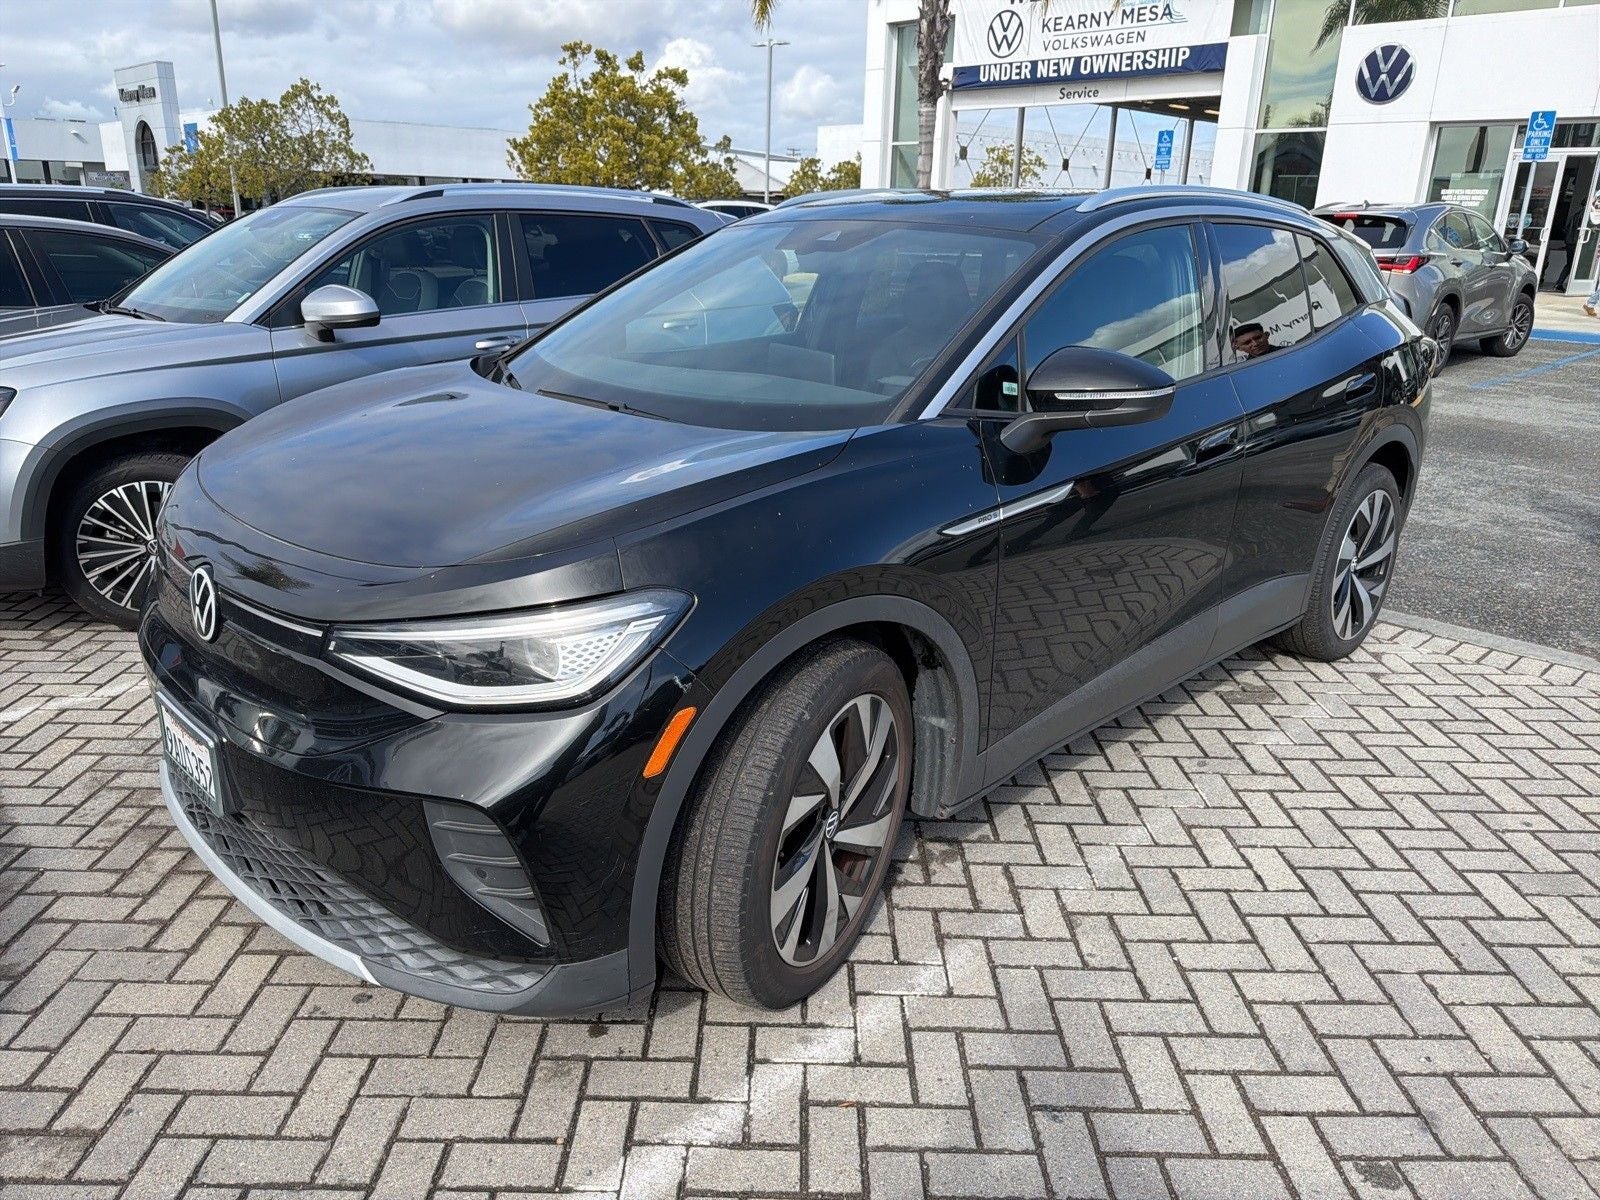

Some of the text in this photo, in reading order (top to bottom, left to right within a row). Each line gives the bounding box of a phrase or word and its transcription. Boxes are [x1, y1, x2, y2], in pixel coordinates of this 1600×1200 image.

[1042, 3, 1173, 34] KEARNY MESA
[1042, 31, 1147, 51] VOLKSWAGEN
[979, 47, 1191, 82] UNDER NEW OWNERSHIP
[1059, 87, 1100, 100] Service
[978, 514, 992, 523] PRO
